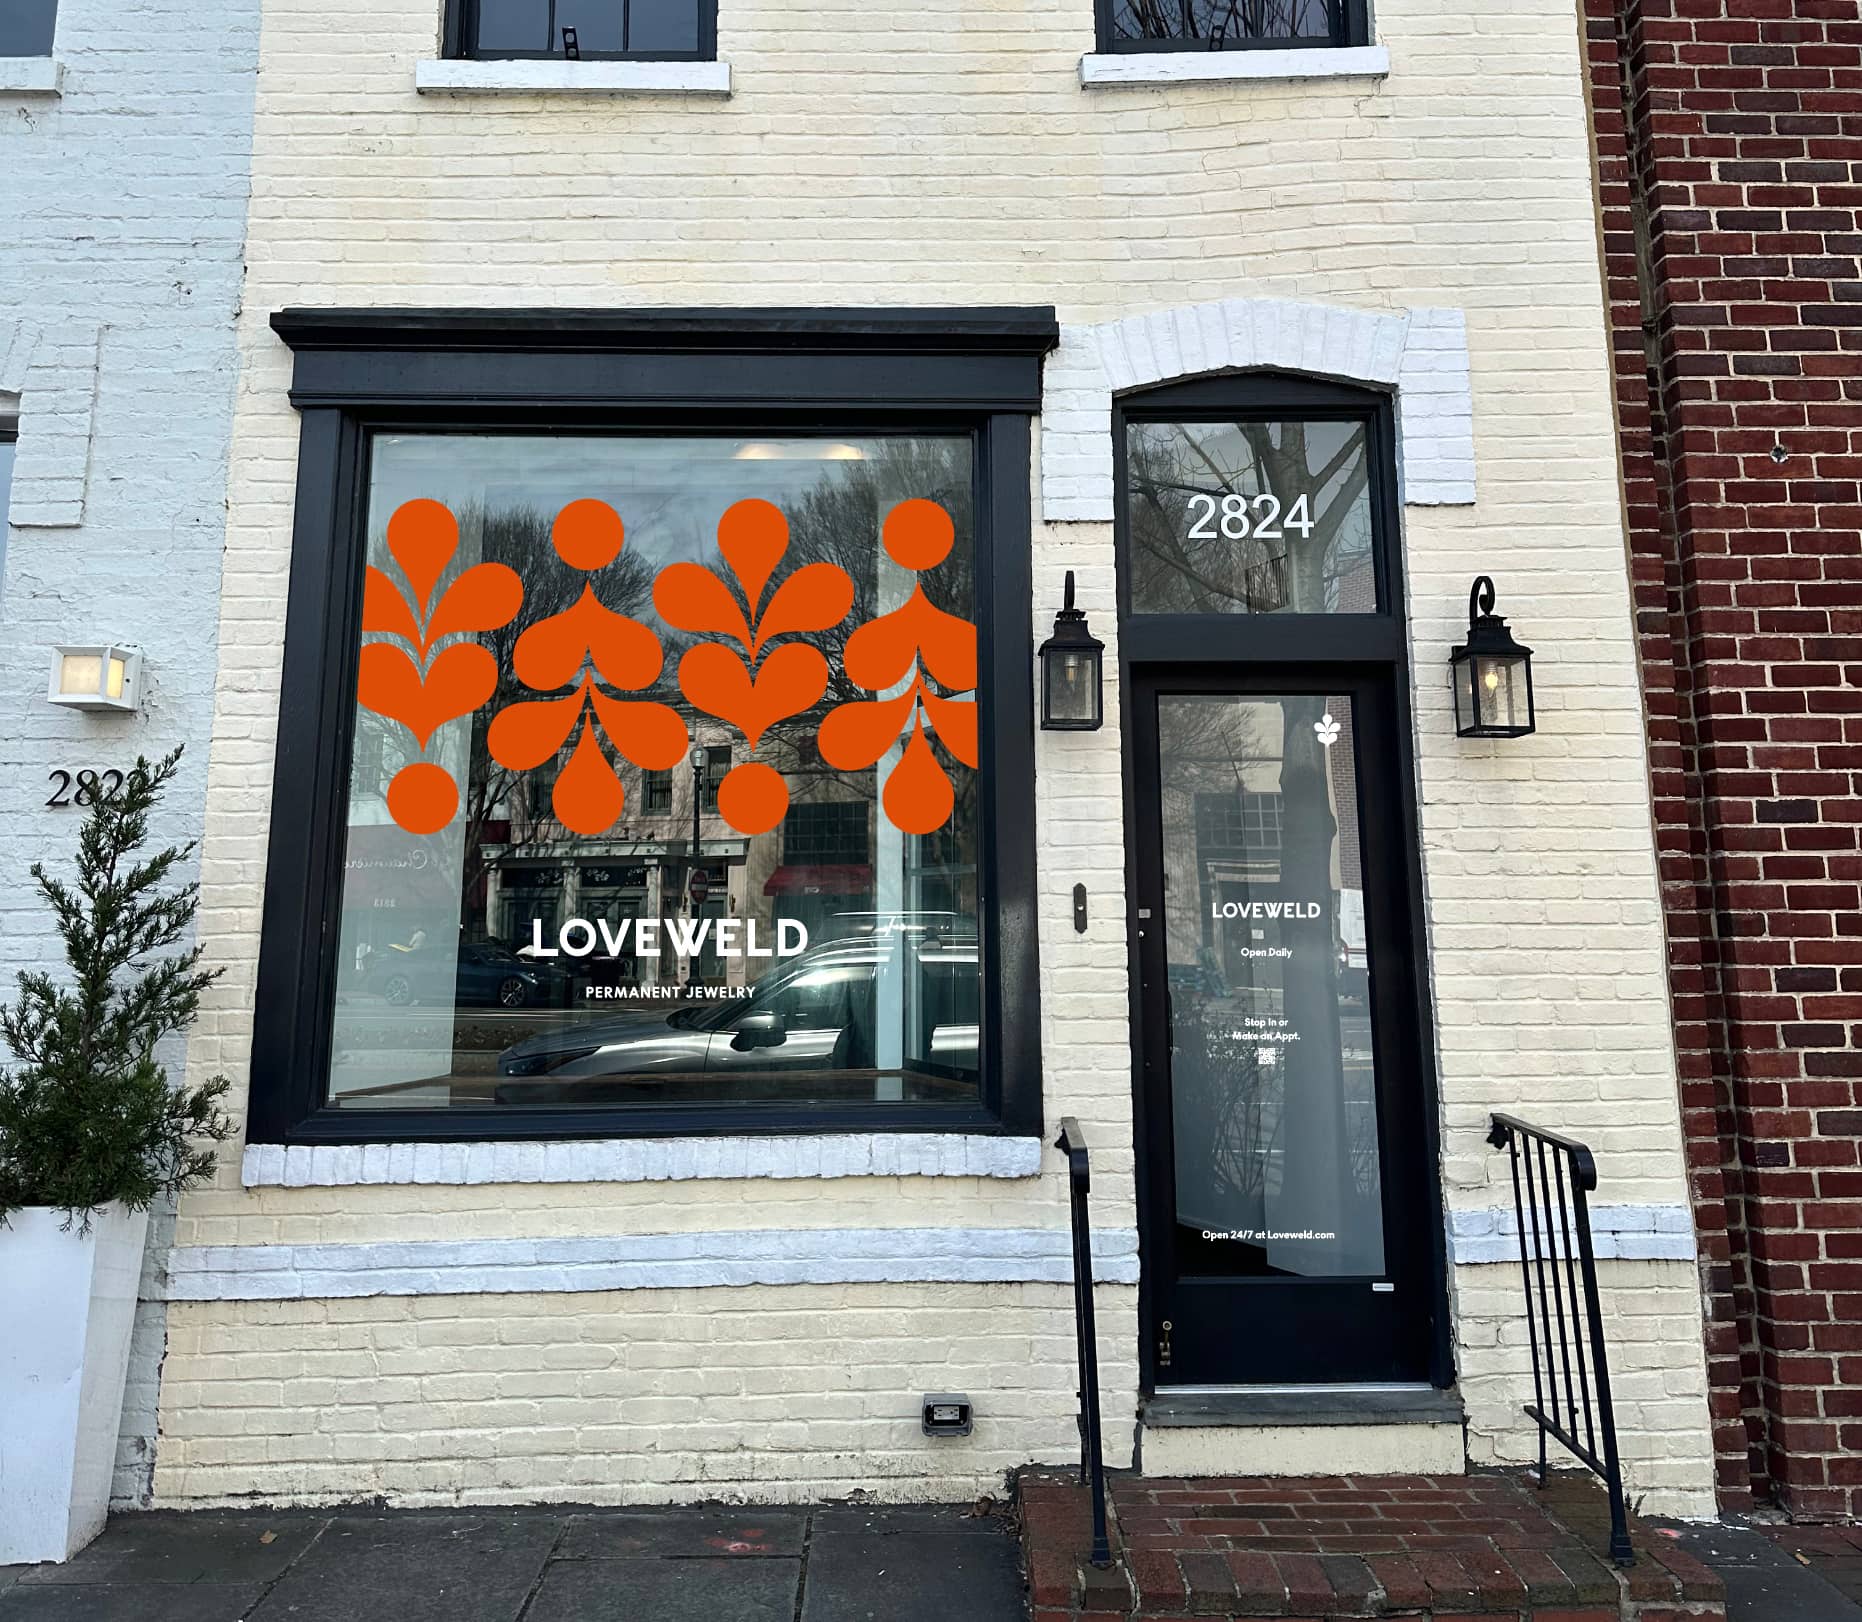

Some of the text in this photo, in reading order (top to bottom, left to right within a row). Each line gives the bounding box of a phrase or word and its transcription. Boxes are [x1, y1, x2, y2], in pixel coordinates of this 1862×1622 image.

[1187, 493, 1315, 539] 2824
[1212, 902, 1321, 919] LOVEWELD
[533, 918, 808, 957] LOVEWELD
[1240, 947, 1293, 960] Open Daily
[585, 985, 755, 999] PERMANENT JEWELRY
[1244, 1016, 1266, 1029] Stop
[1278, 1018, 1289, 1027] or
[1232, 1031, 1301, 1044] Make an Appt.
[1202, 1230, 1336, 1242] Open 24/7 at Loveweld.com
